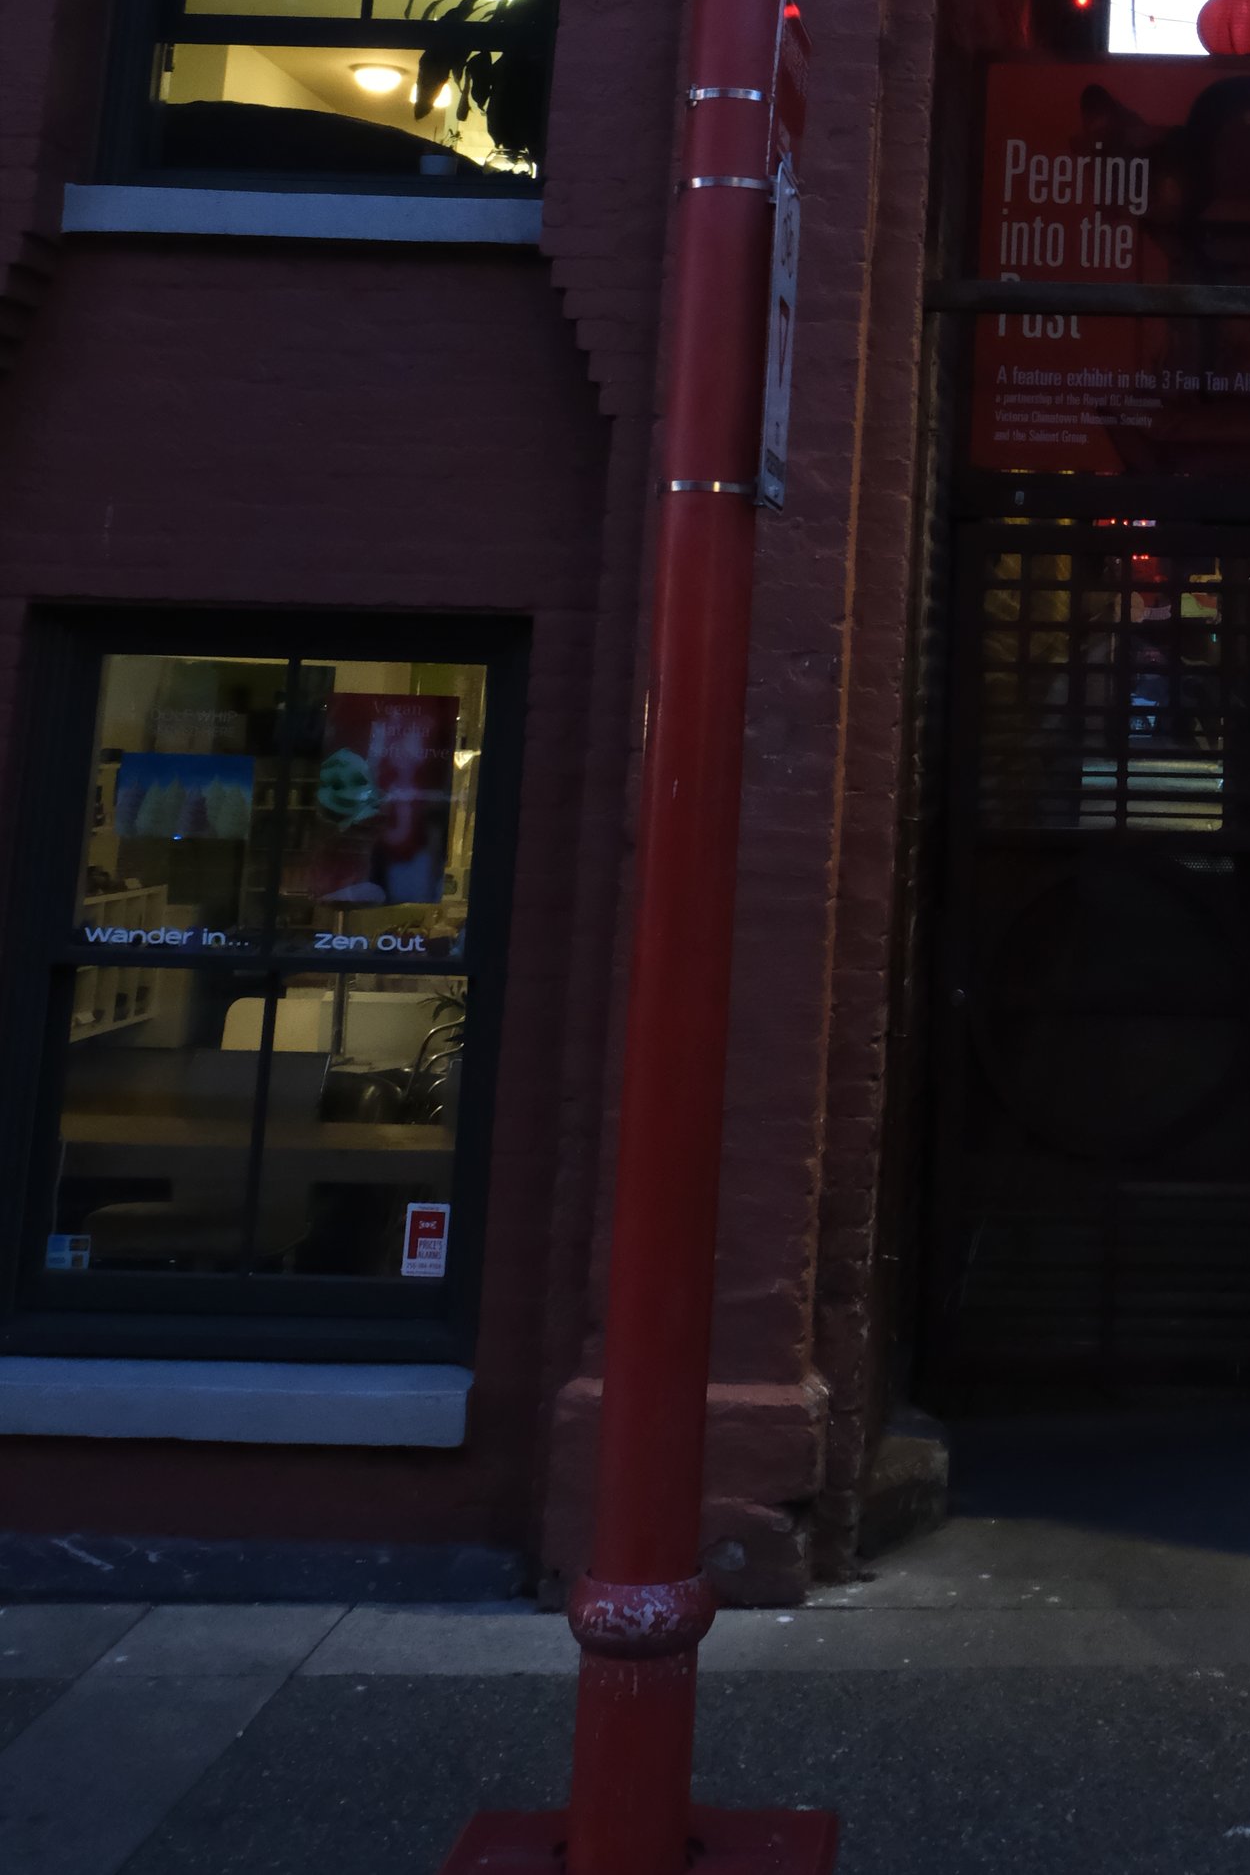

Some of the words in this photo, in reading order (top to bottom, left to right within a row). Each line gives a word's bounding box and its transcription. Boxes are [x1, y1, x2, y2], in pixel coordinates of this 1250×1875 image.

[1004, 139, 1150, 215] Peering
[1000, 208, 1065, 267] into
[1080, 211, 1134, 269] the
[997, 365, 1007, 385] A
[1013, 366, 1061, 386] feature
[1067, 367, 1113, 388] exhibit
[1118, 369, 1130, 388] in
[1135, 370, 1156, 389] the
[1162, 370, 1171, 389] 3
[1176, 371, 1199, 390] Fan
[1205, 372, 1228, 391] Tan
[1066, 394, 1080, 406] the
[84, 926, 194, 947] Wander
[313, 931, 369, 951] Zen
